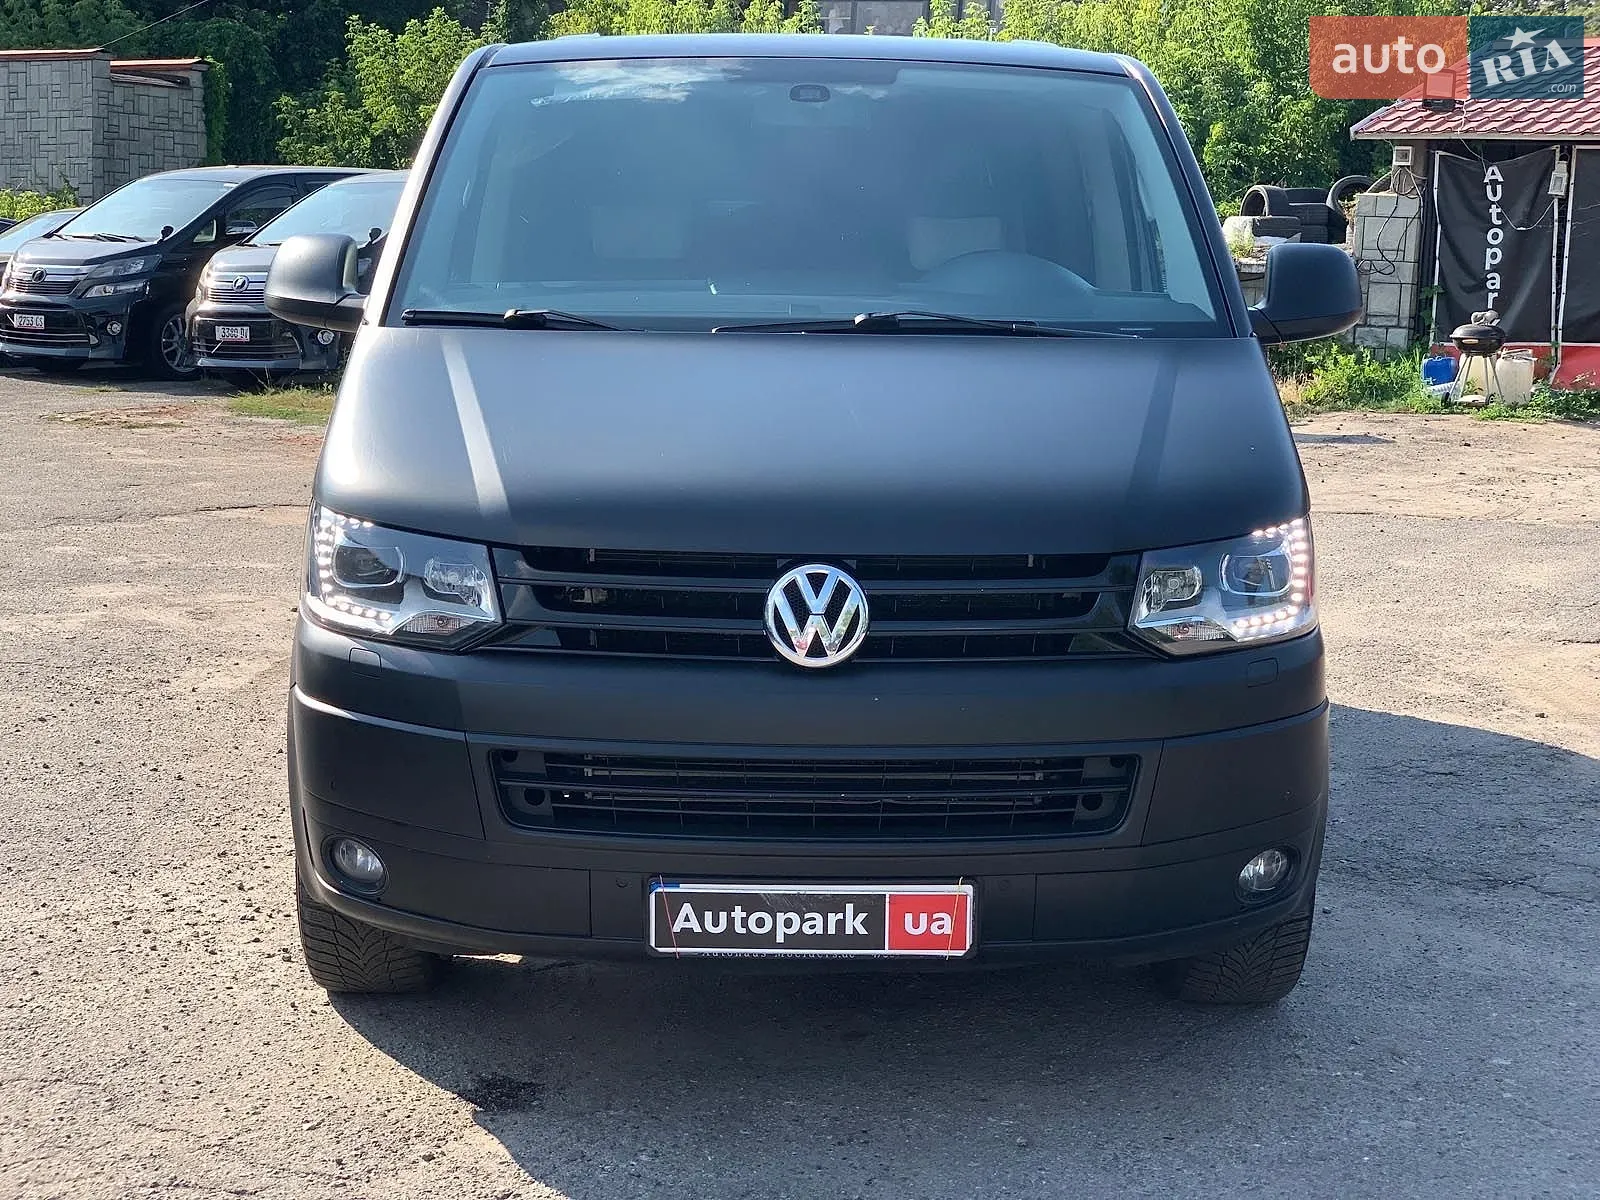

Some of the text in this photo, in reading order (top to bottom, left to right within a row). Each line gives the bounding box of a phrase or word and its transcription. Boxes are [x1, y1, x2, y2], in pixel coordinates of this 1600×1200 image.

[1483, 165, 1504, 326] Autopar
[672, 902, 952, 944] Autopark ua
